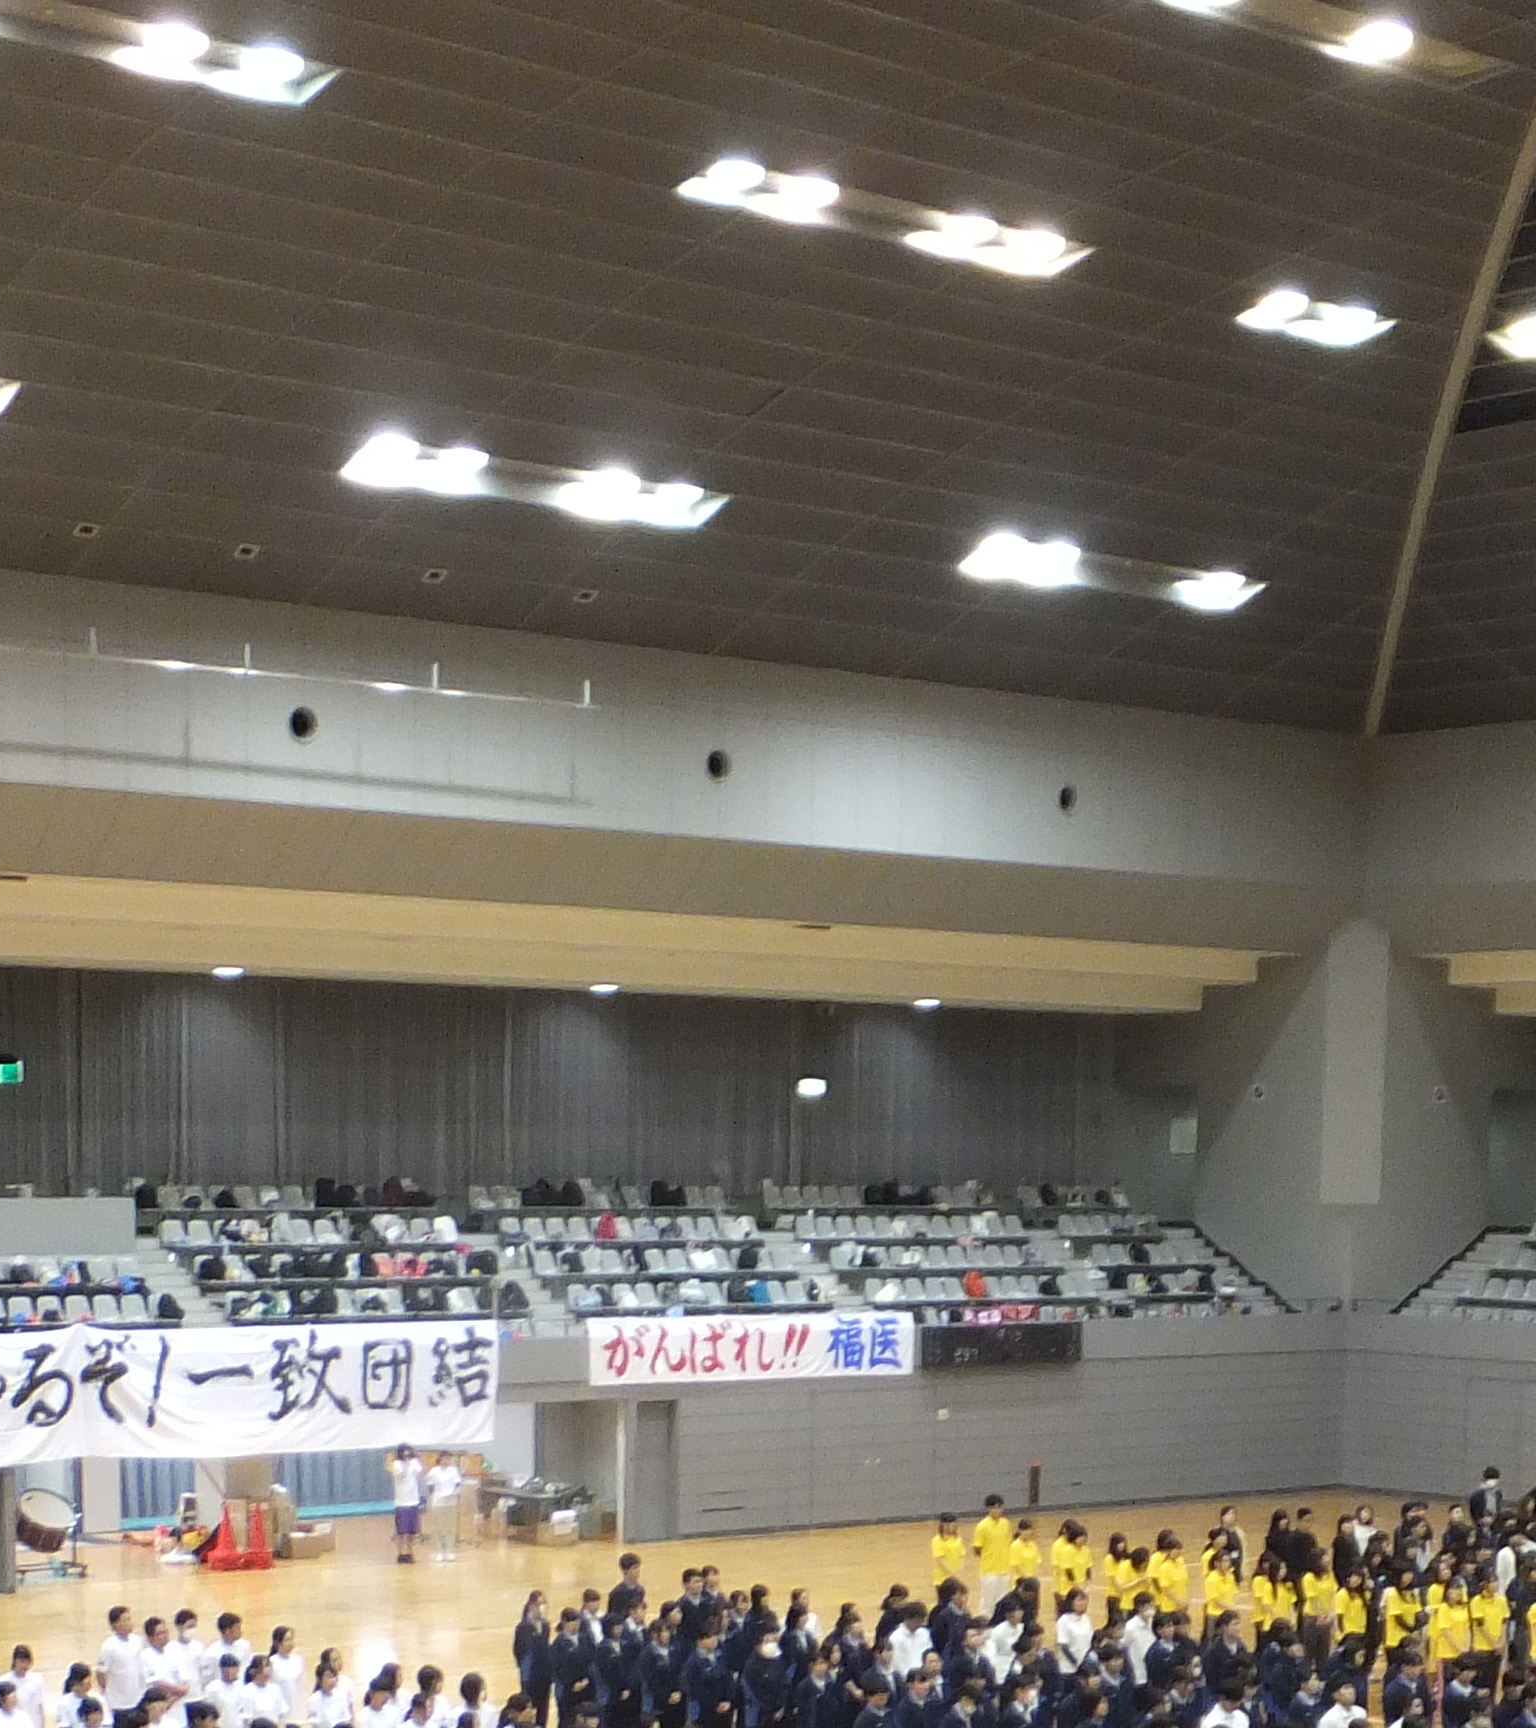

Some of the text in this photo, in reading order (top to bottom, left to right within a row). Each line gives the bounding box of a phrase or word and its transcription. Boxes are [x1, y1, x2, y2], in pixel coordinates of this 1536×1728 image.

[602, 1315, 904, 1379] がんばれ!! 福医
